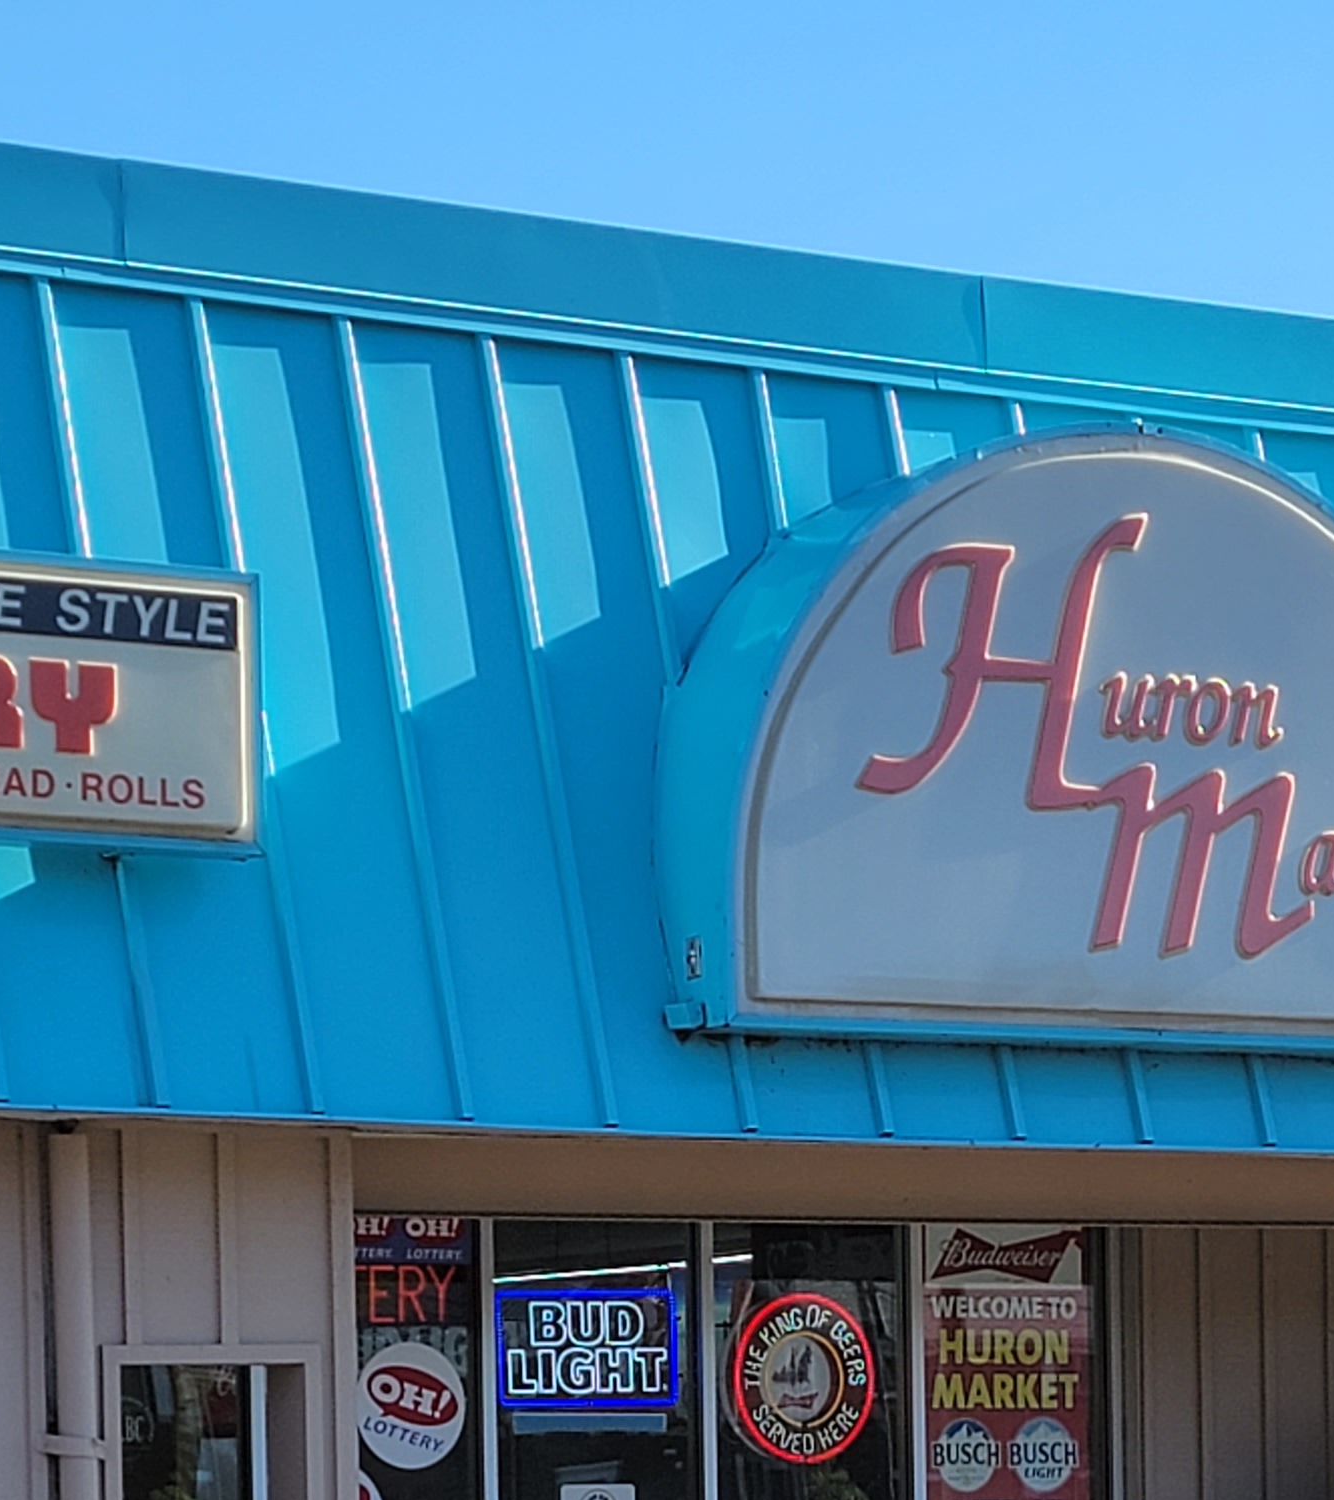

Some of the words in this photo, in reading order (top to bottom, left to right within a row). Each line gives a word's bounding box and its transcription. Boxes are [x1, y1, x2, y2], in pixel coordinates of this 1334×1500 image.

[55, 588, 230, 645] STYLE
[854, 510, 1285, 812] Huron
[80, 770, 206, 810] ROLLS
[405, 1217, 459, 1238] OH!
[941, 1237, 1063, 1268] Budweiser
[528, 1301, 644, 1347] BUD
[931, 1295, 1044, 1319] WELCOME
[1047, 1296, 1077, 1320] TO
[744, 1345, 768, 1391] THE
[759, 1307, 804, 1347] KING
[805, 1304, 833, 1328] OF
[830, 1320, 867, 1387] BEERS
[939, 1328, 1069, 1365] HURON
[507, 1347, 667, 1394] LIGHT
[371, 1373, 451, 1418] OH!
[932, 1373, 1079, 1409] MARKET
[363, 1416, 445, 1452] LOTTERY
[752, 1404, 815, 1454] SERVED
[818, 1402, 860, 1450] HERE
[933, 1443, 1000, 1467] BUSCH
[1009, 1442, 1078, 1467] BUSCH
[1024, 1467, 1063, 1479] LIGHT
